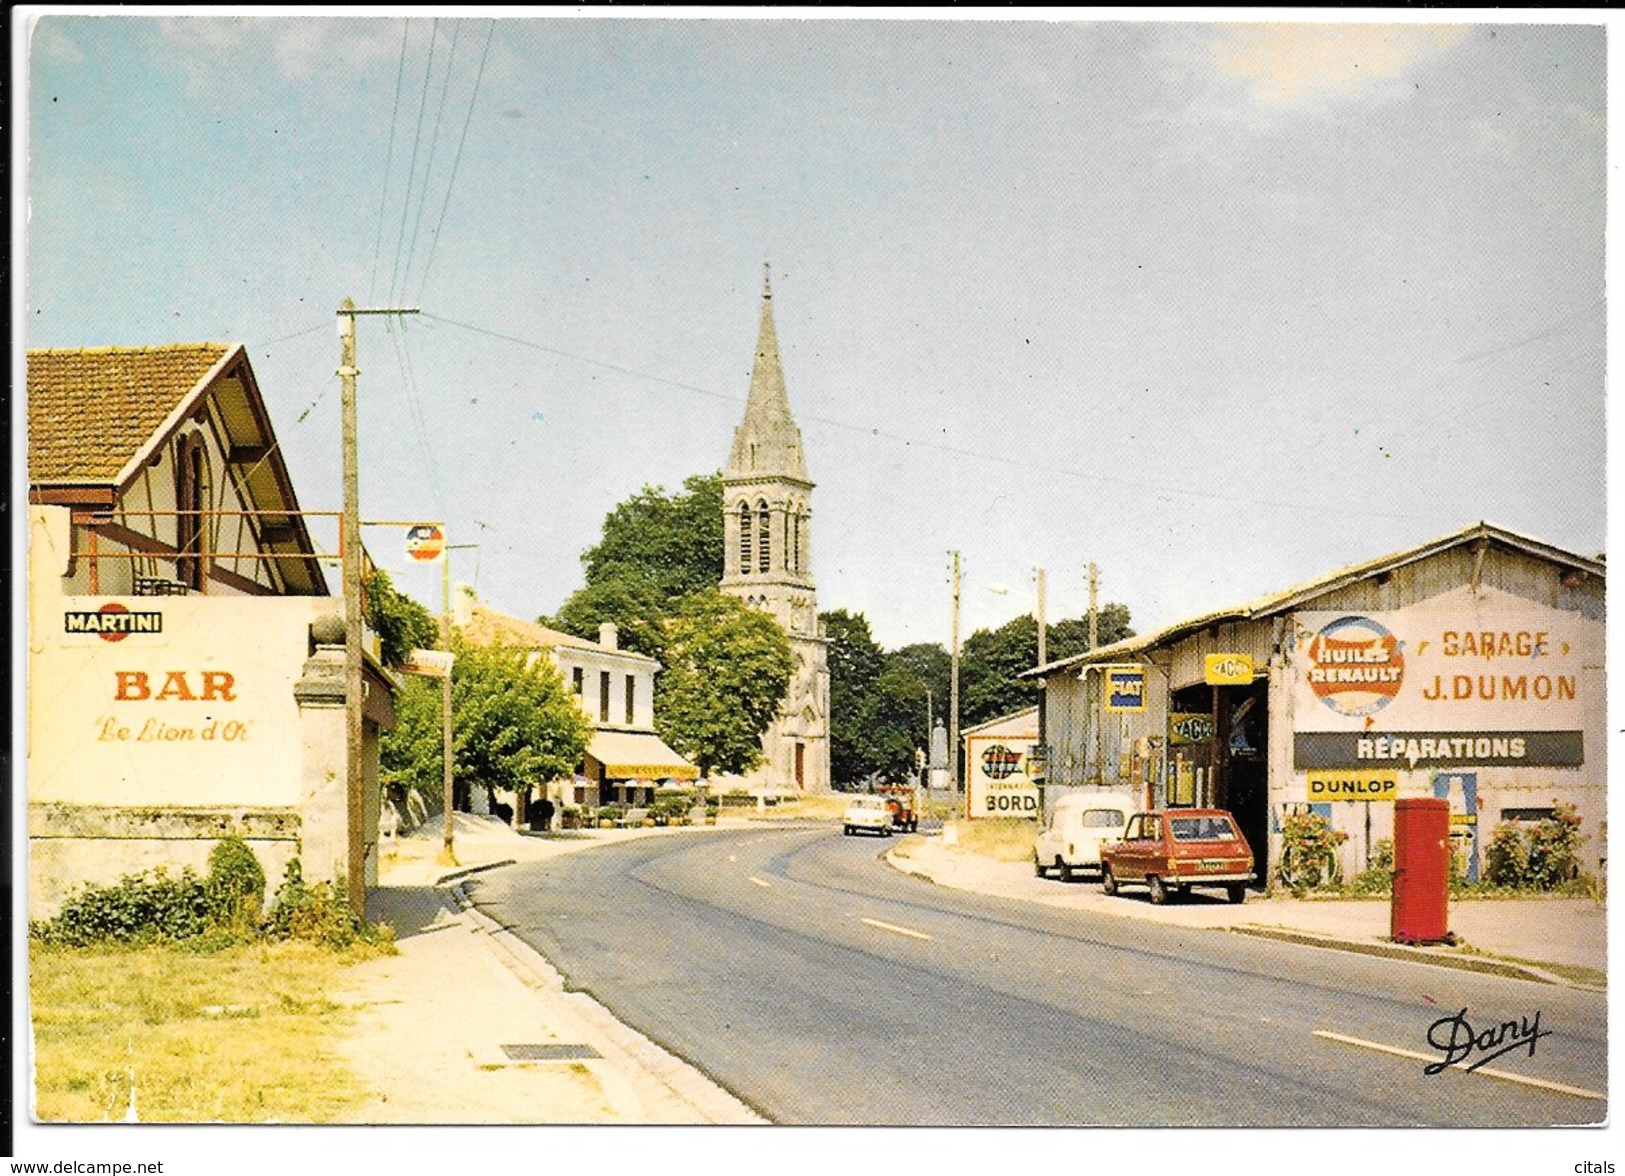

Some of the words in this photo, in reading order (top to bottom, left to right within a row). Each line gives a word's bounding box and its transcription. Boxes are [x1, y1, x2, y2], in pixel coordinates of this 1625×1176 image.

[67, 614, 160, 632] MARTINI
[1443, 631, 1548, 656] GARAGE
[1317, 648, 1390, 663] HUILES
[1311, 668, 1401, 683] RENAULT
[114, 671, 237, 702] BAR
[1110, 680, 1142, 697] FIAT
[137, 717, 195, 742] Lion
[1357, 732, 1526, 760] RÉPARATIONS
[1311, 781, 1395, 794] DUNLOP
[986, 795, 1037, 811] BORD
